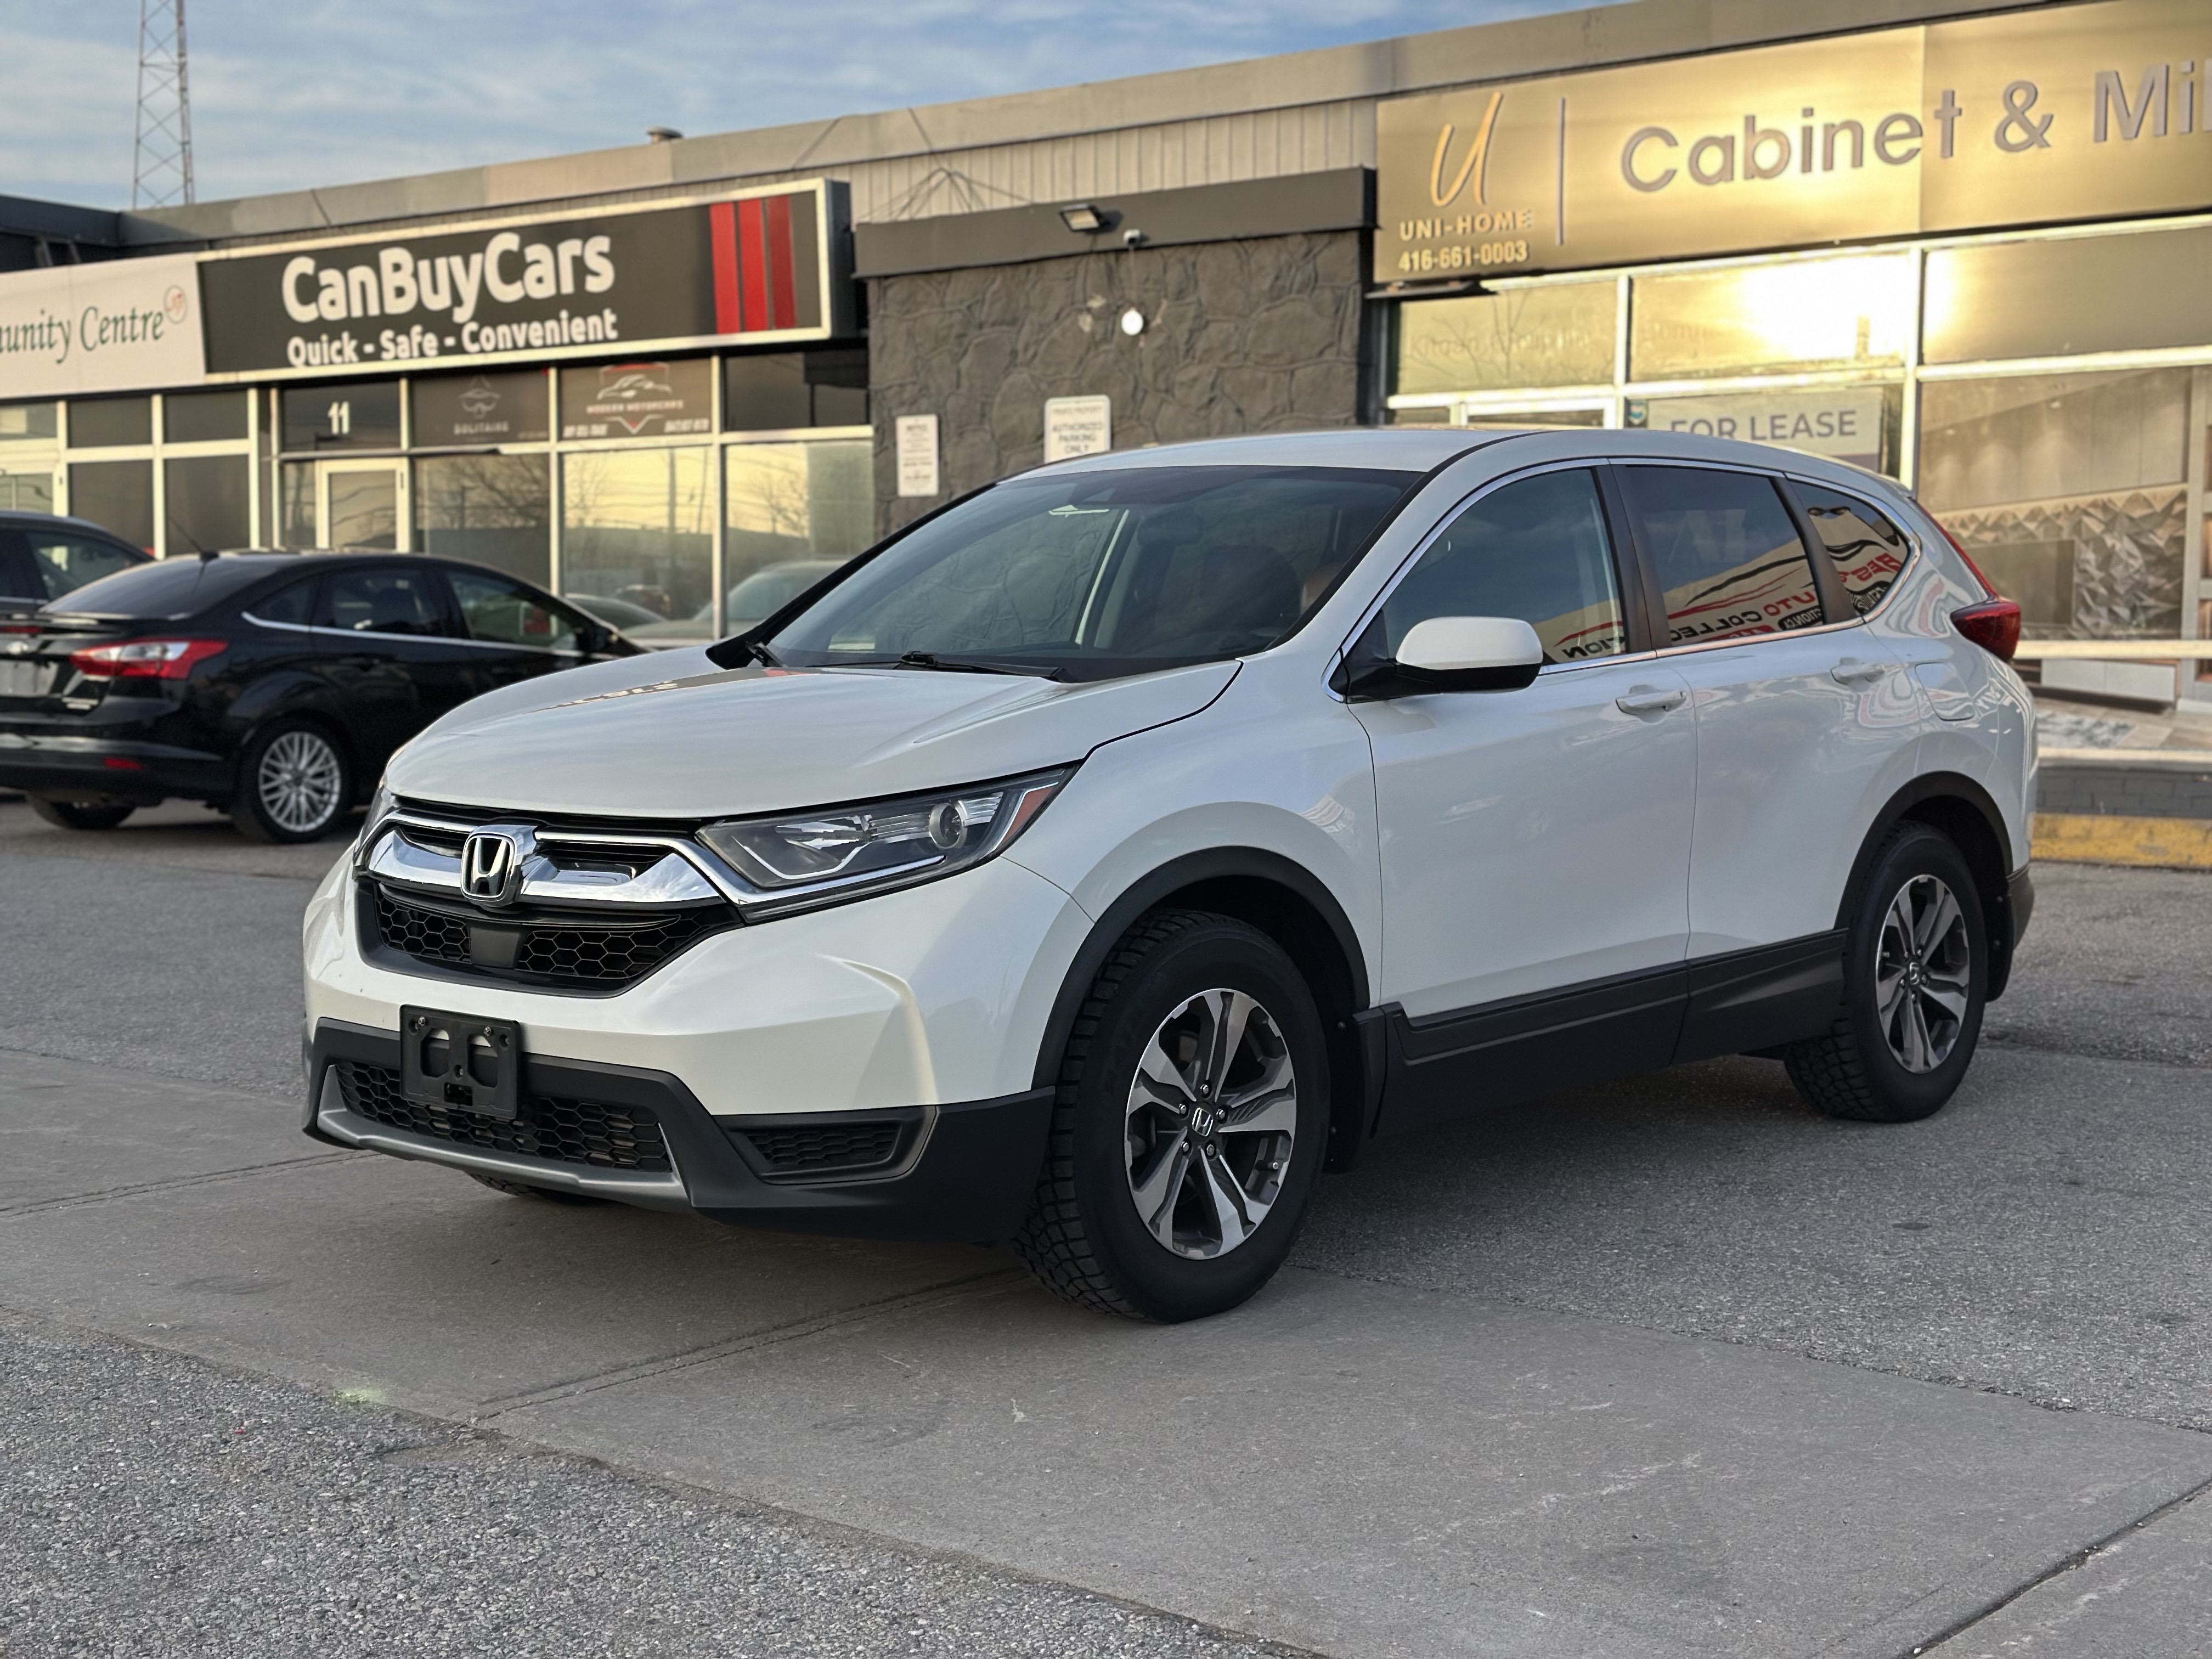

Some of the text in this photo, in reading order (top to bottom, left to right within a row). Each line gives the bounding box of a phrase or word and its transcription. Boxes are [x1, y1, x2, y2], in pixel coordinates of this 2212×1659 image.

[1621, 89, 1962, 193] Cabinet
[1993, 80, 2054, 153] &
[1399, 209, 1532, 241] UNI-HOME
[281, 232, 615, 324] CanBuyCars
[1398, 239, 1529, 272] 416-661-0003
[0, 306, 164, 364] unity Centre
[287, 331, 359, 368] Quick
[380, 325, 438, 360] Safe
[461, 309, 618, 353] Convenient
[328, 402, 349, 435] 11
[1750, 410, 1858, 441] LEASE
